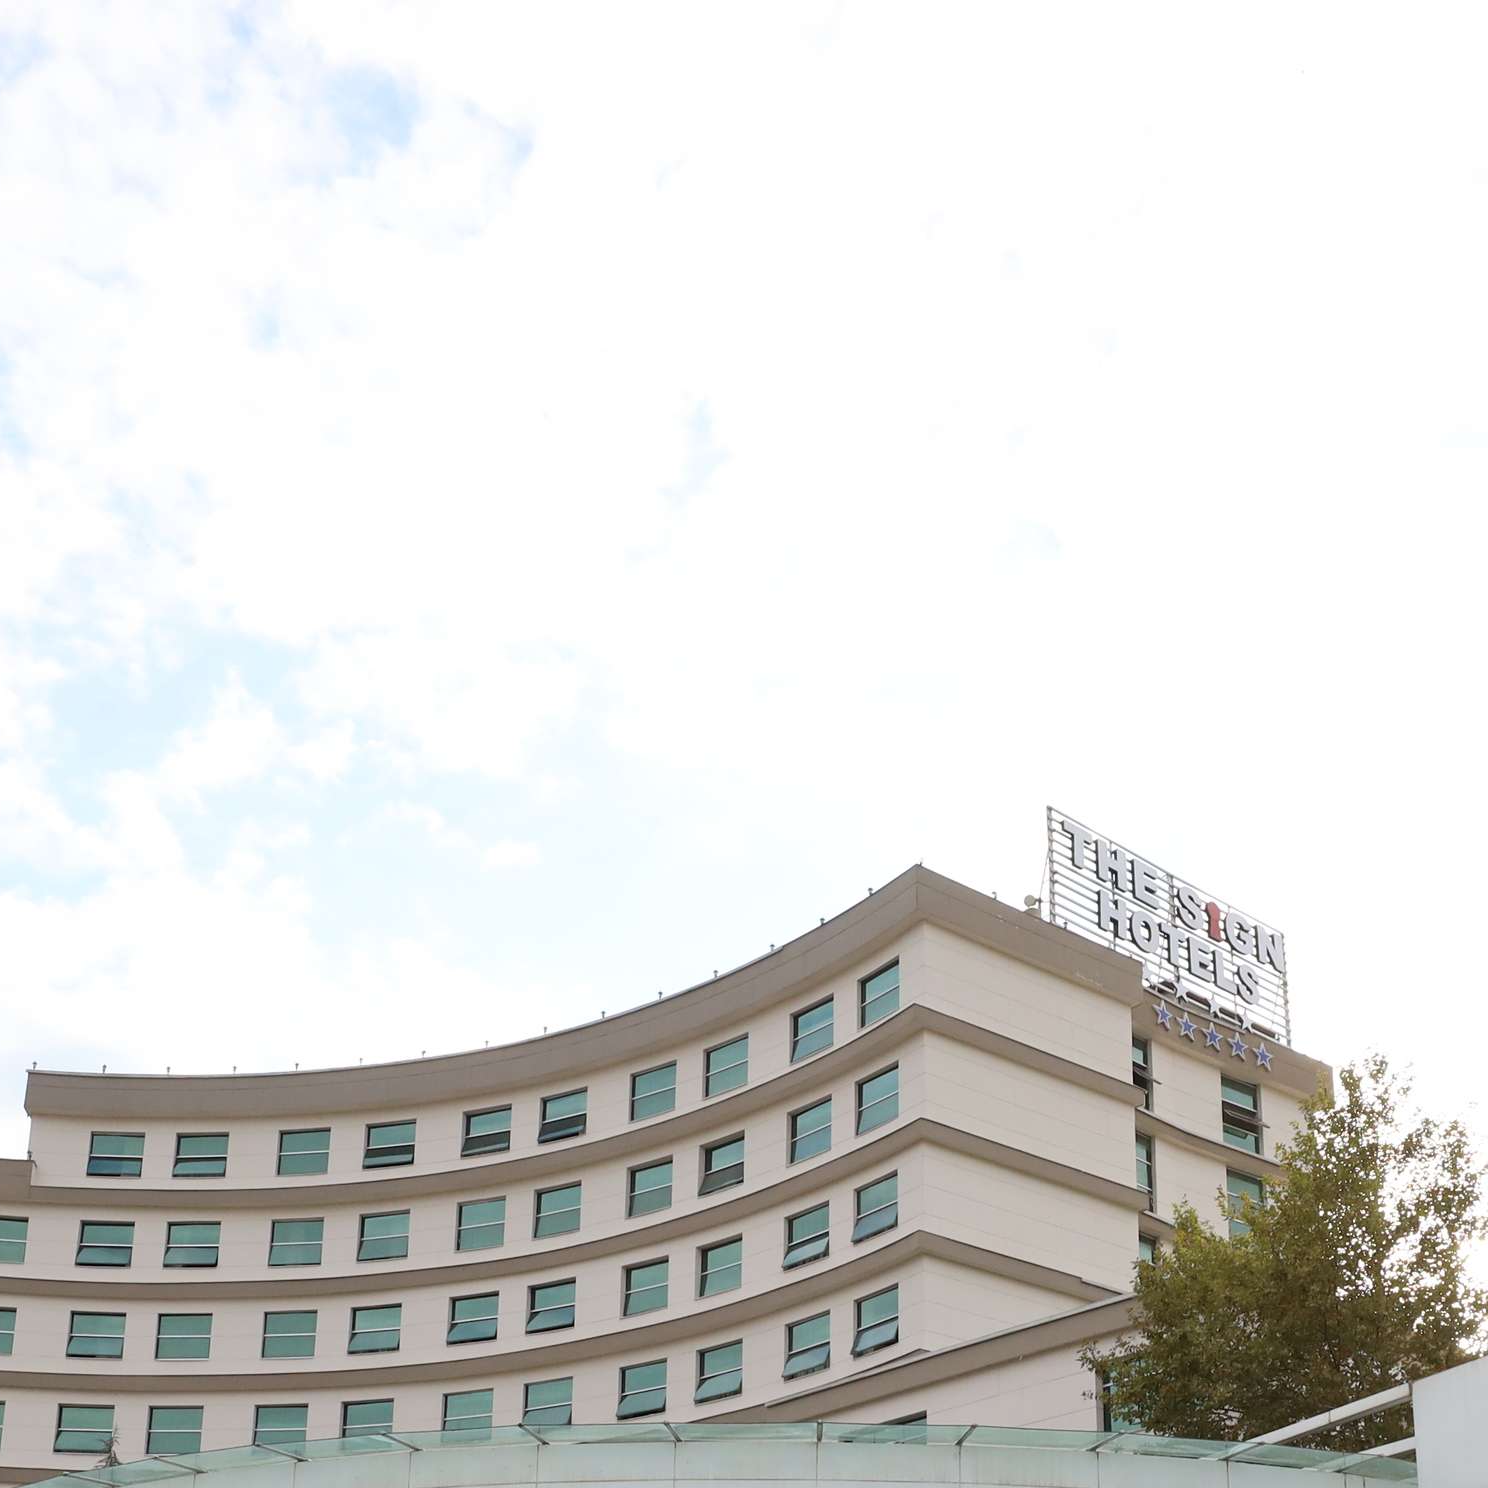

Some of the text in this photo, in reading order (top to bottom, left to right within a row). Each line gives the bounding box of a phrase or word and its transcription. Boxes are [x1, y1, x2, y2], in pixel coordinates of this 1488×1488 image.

[1062, 820, 1286, 974] THE SIGN
[1097, 889, 1260, 1005] HOTELS
